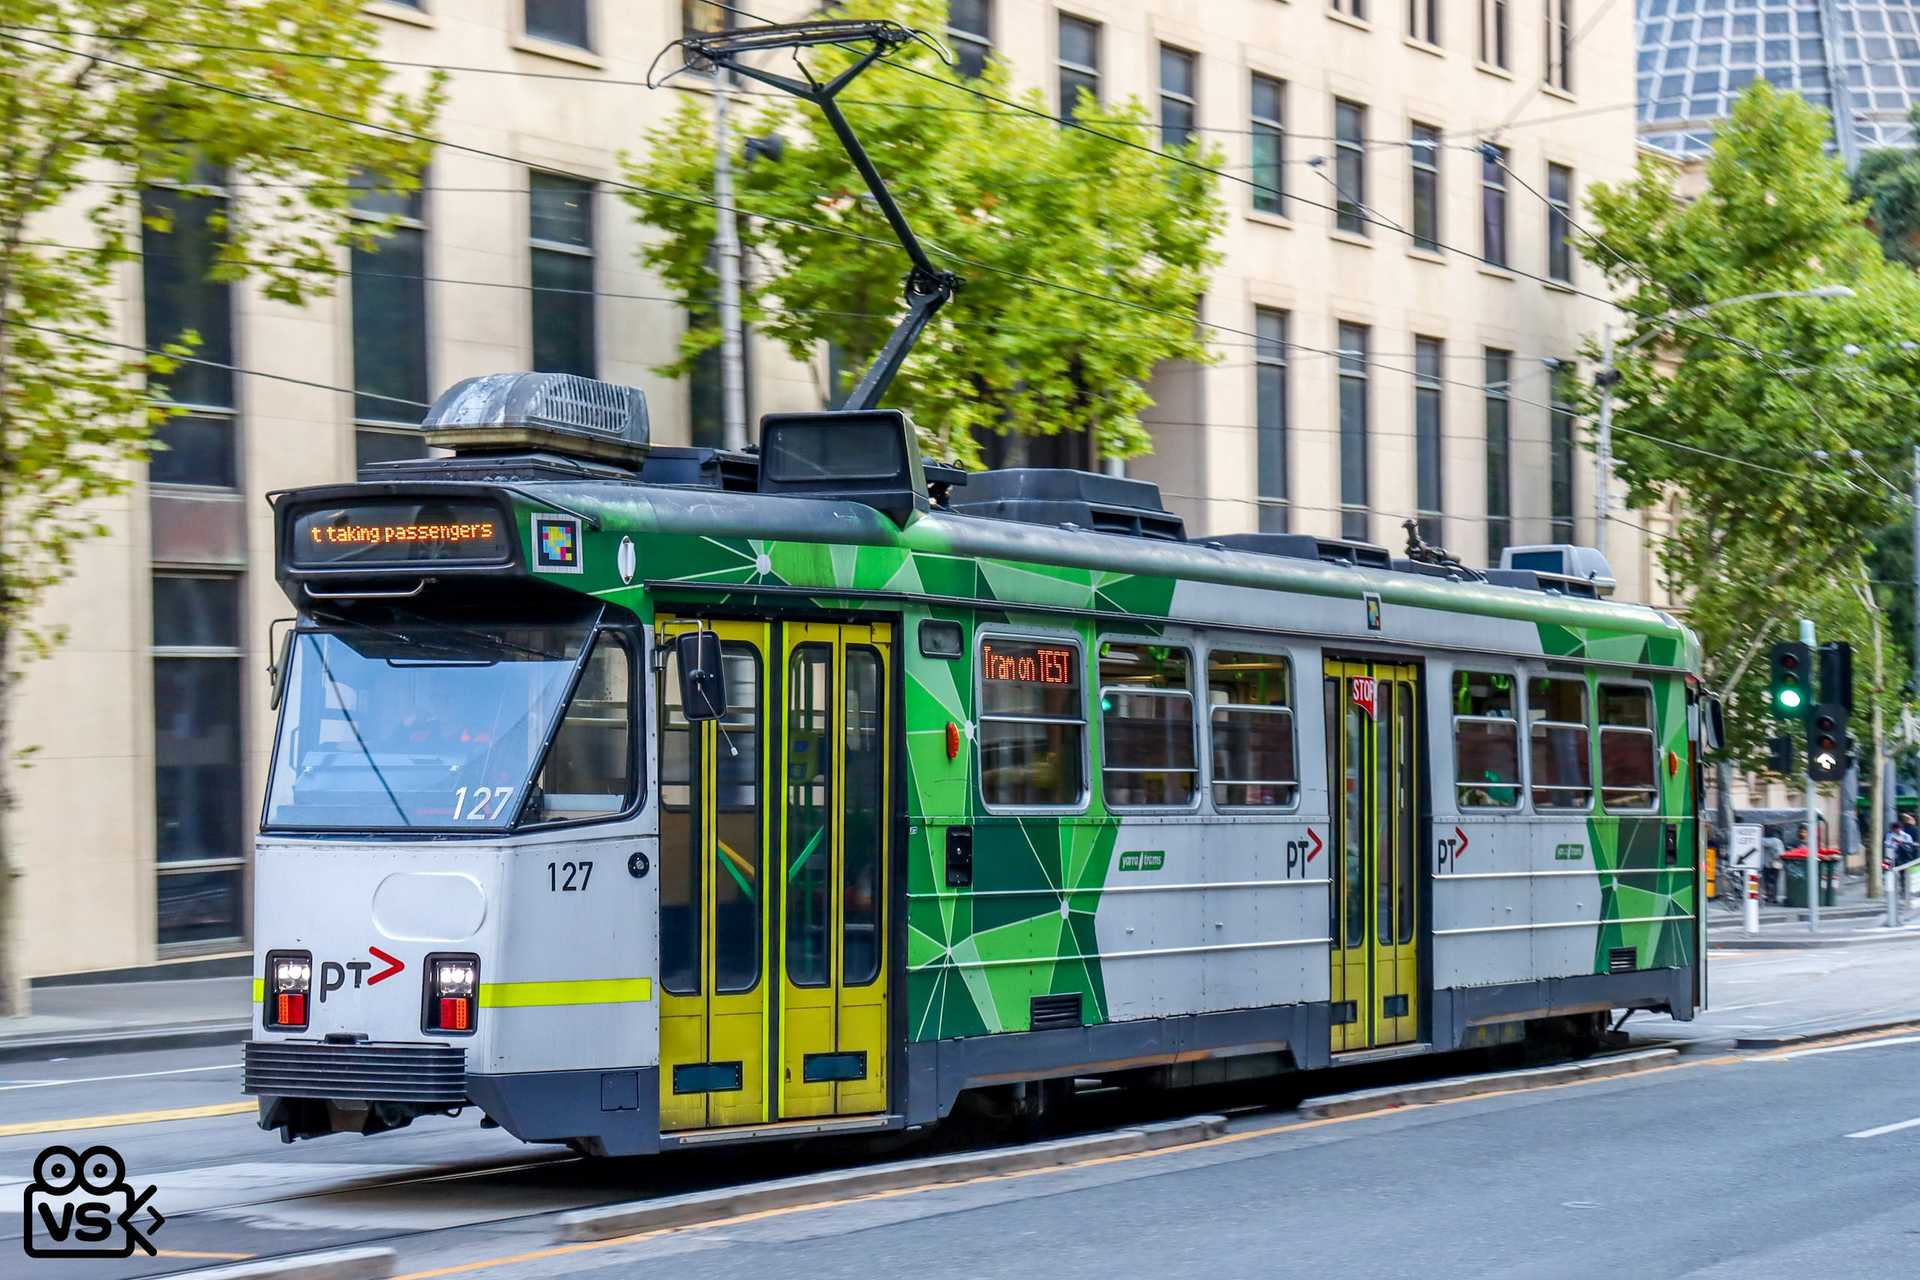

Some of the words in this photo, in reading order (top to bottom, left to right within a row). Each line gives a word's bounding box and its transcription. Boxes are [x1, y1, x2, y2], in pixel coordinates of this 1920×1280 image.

[311, 526, 321, 543] t
[326, 525, 380, 543] taking
[384, 523, 493, 543] passengers
[983, 645, 1015, 680] Tram
[1018, 656, 1036, 681] on
[1037, 649, 1070, 683] TEST
[453, 786, 514, 821] 127
[547, 861, 593, 892] 127
